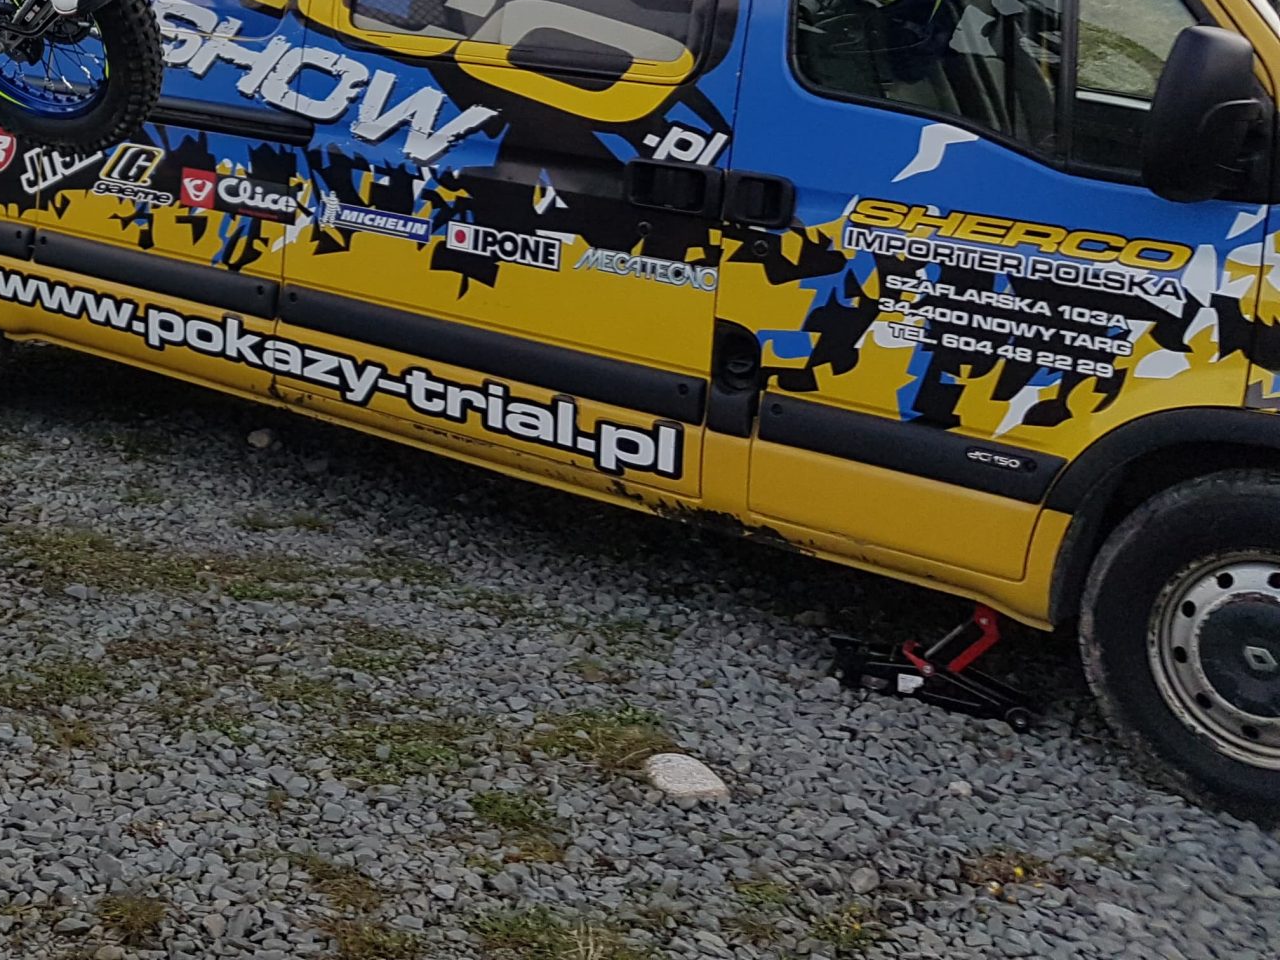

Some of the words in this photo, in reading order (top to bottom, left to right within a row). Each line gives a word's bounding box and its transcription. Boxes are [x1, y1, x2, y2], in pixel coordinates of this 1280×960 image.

[217, 177, 298, 213] Clice
[340, 210, 428, 235] MICHELIN
[472, 228, 557, 267] IPONE
[848, 198, 1193, 271] SHERCO
[844, 227, 1025, 277] IMPORTER
[1027, 256, 1187, 303] POLSKA
[878, 297, 969, 326] 34-400
[971, 314, 1057, 342] NOWY
[1059, 330, 1134, 357] TARG
[885, 275, 1052, 317] SZAFLARSKA
[1057, 305, 1129, 331] 103A
[941, 333, 994, 355] 604
[996, 344, 1033, 362] 48
[1036, 351, 1073, 371] 22
[1076, 359, 1114, 378] 29
